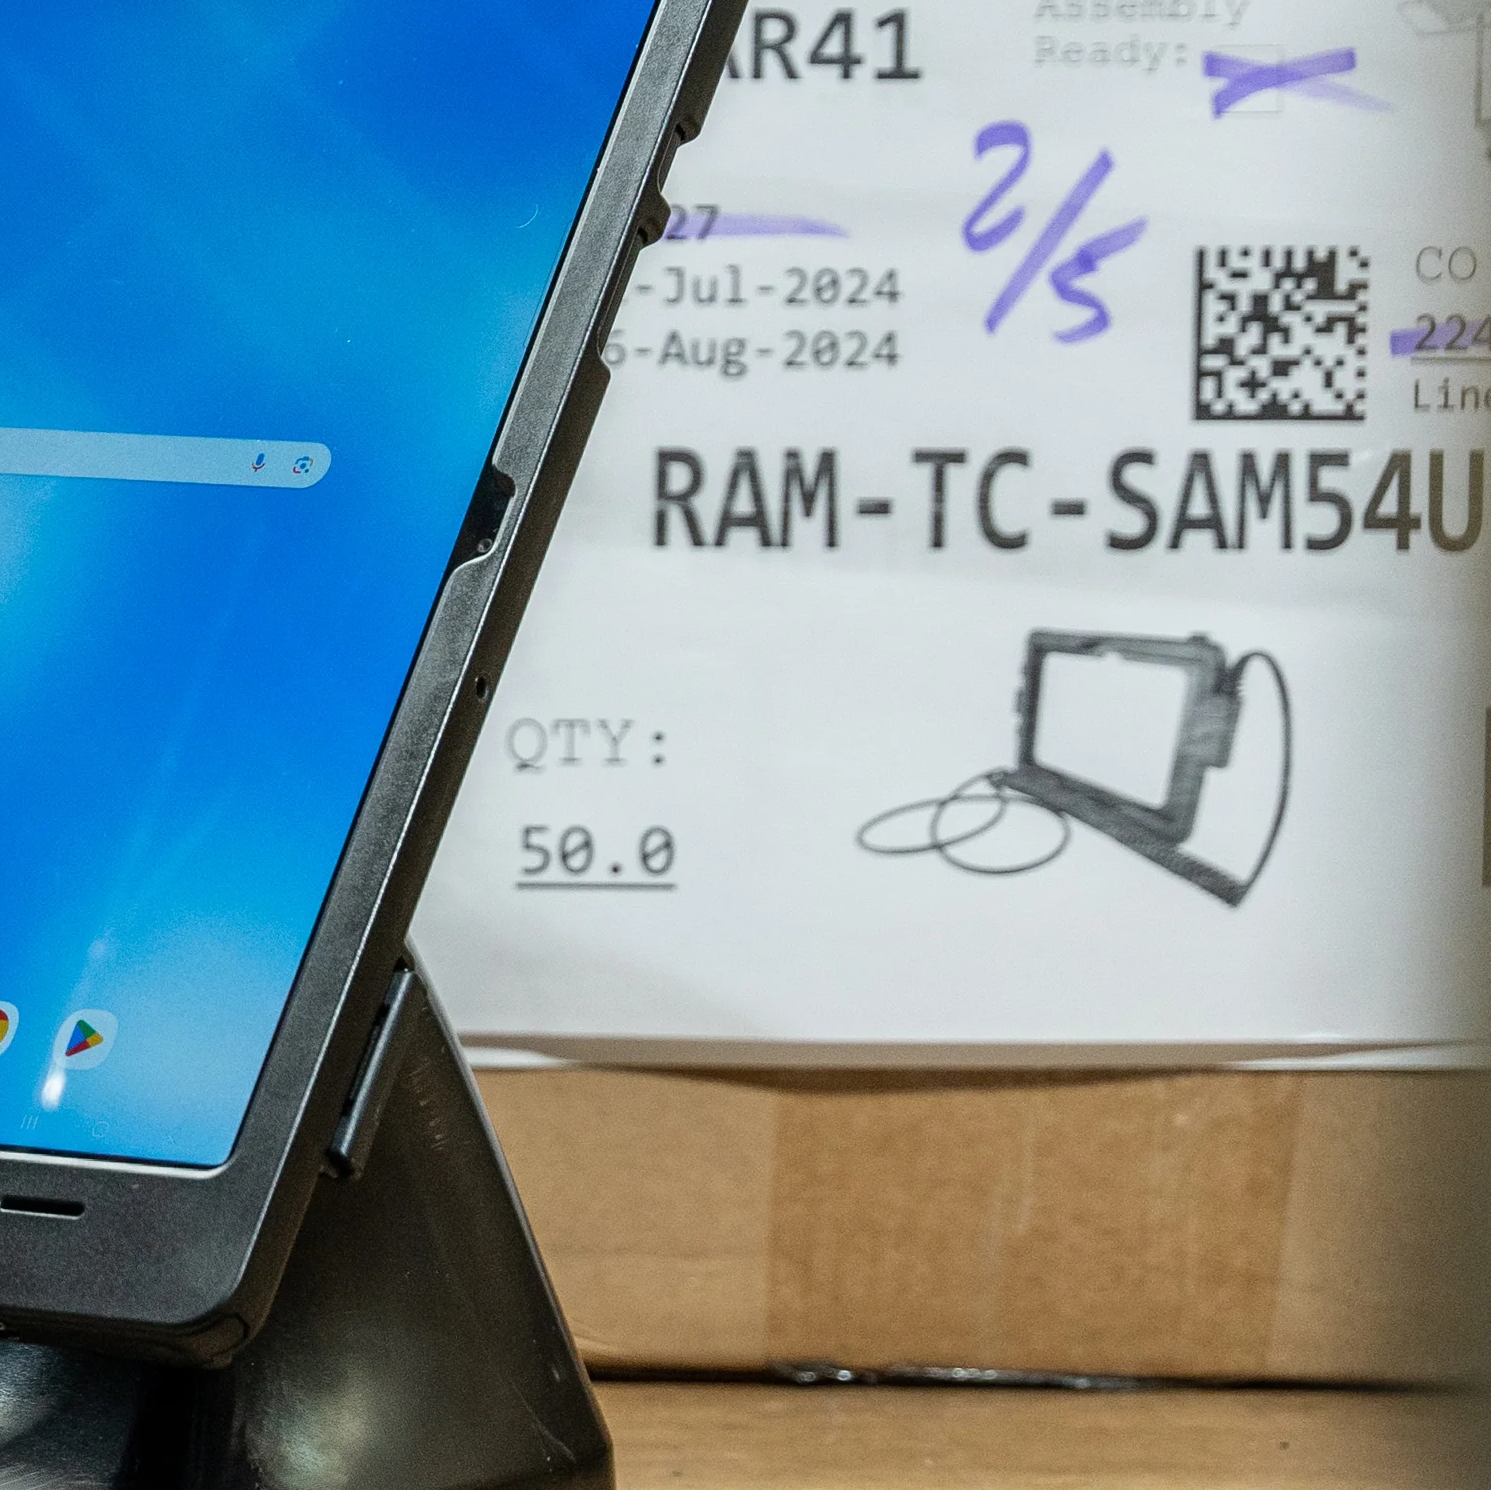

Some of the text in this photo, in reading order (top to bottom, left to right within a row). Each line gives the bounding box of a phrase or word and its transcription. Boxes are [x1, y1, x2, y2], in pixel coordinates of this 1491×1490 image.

[1033, 34, 1188, 75] Ready:
[961, 120, 1149, 344] 2/5
[1416, 245, 1478, 283] CO
[1414, 377, 1491, 412] Lin
[652, 447, 1485, 554] RAM-TC-SAM54U
[505, 717, 669, 773] QTY:
[518, 824, 675, 878] 50.0
